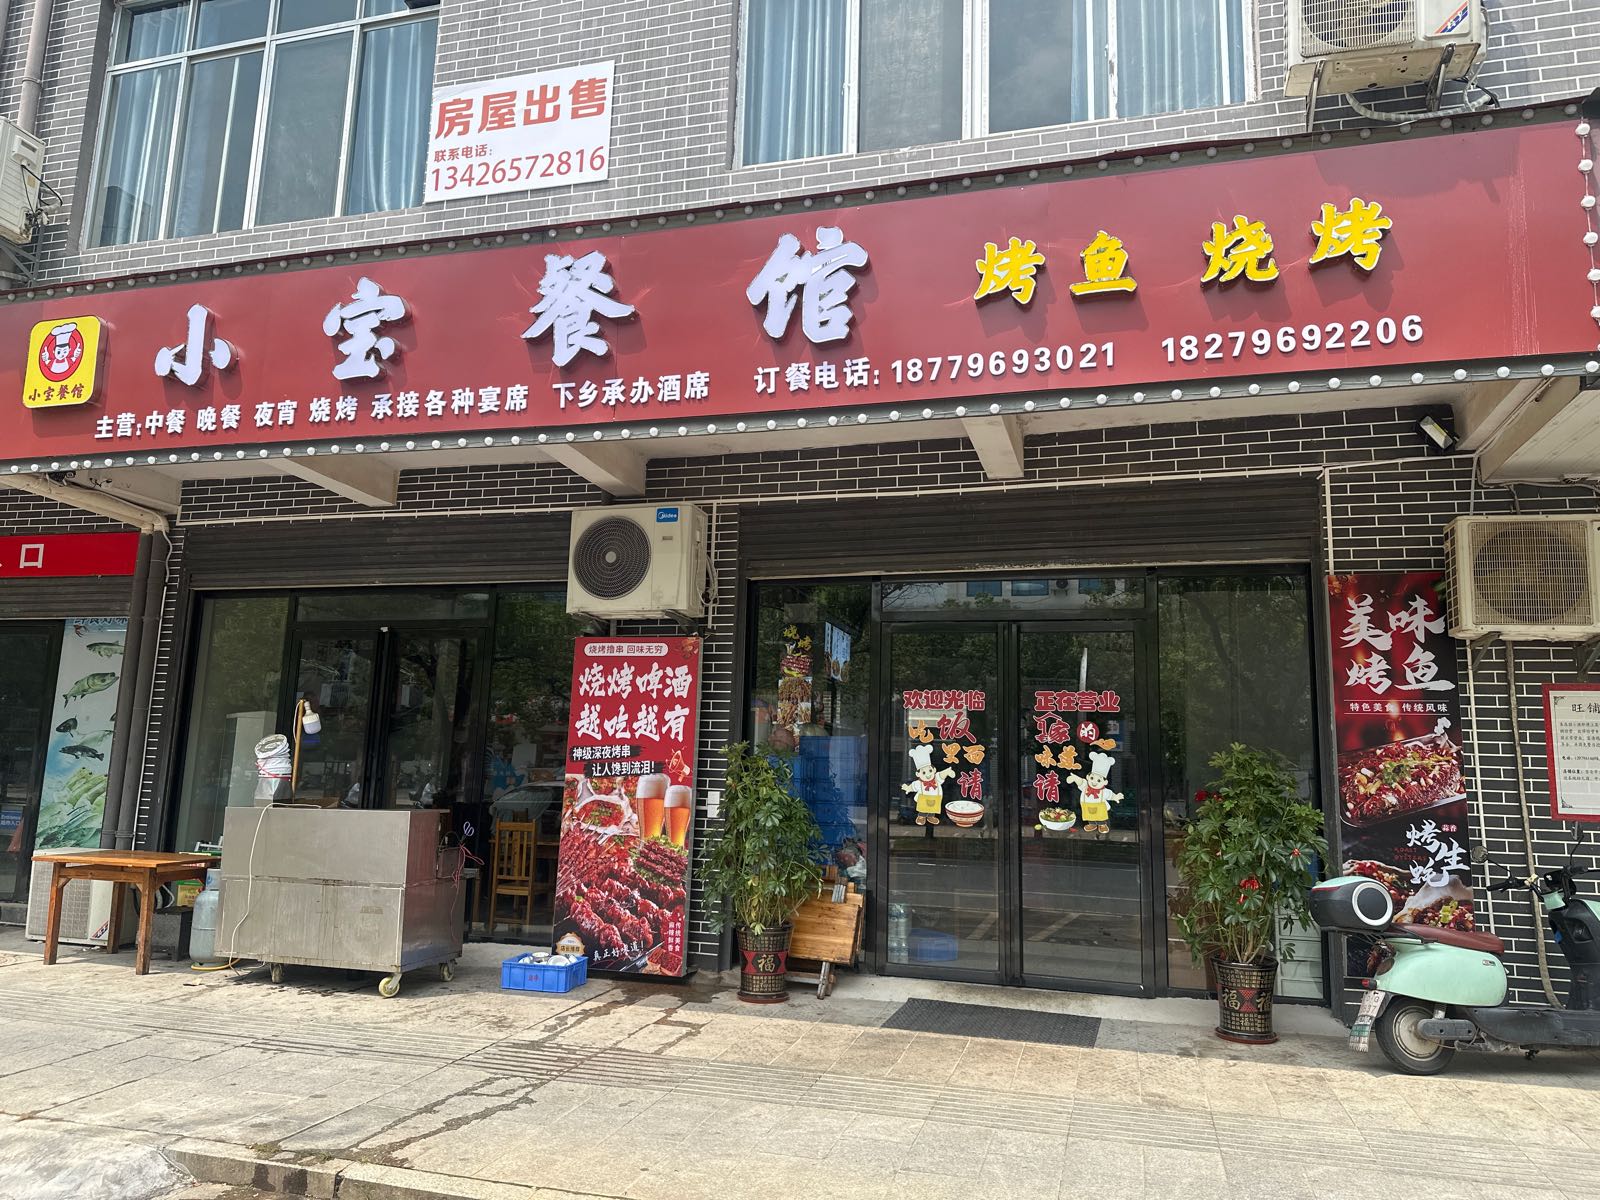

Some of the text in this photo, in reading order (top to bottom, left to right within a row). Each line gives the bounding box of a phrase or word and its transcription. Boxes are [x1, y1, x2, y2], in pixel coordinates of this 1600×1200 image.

[434, 77, 608, 140] 房屋出售
[431, 145, 605, 192] 13426572816
[433, 143, 494, 162] 联系电话:
[973, 197, 1392, 305] 烤鱼 烧烤
[154, 225, 869, 387] 小宝餐馆
[1160, 314, 1424, 364] 18279692206
[28, 383, 85, 402] 小宝餐馆
[196, 407, 242, 432] 晚餐
[253, 400, 298, 427] 夜宵
[308, 394, 359, 423] 烧烤
[370, 384, 529, 421] 承接各种宴席
[552, 370, 710, 409] 下乡承办酒席
[1339, 593, 1447, 651] 美味
[588, 645, 663, 655] 烧烤撸串 回味无穷
[578, 661, 693, 699] 烧烤啤酒
[1344, 641, 1456, 695] 烤鱼
[903, 689, 986, 711] 欢迎光临
[1034, 690, 1120, 712] 正在营业
[1350, 702, 1448, 713] 特色美食 传统风味
[575, 702, 691, 742] 越吃越有
[572, 744, 631, 761] 神级深夜烤串
[942, 743, 985, 765] 里面
[957, 768, 984, 800] 请
[1033, 770, 1061, 803] 请
[757, 954, 776, 973] 福
[1222, 988, 1240, 1010] 福
